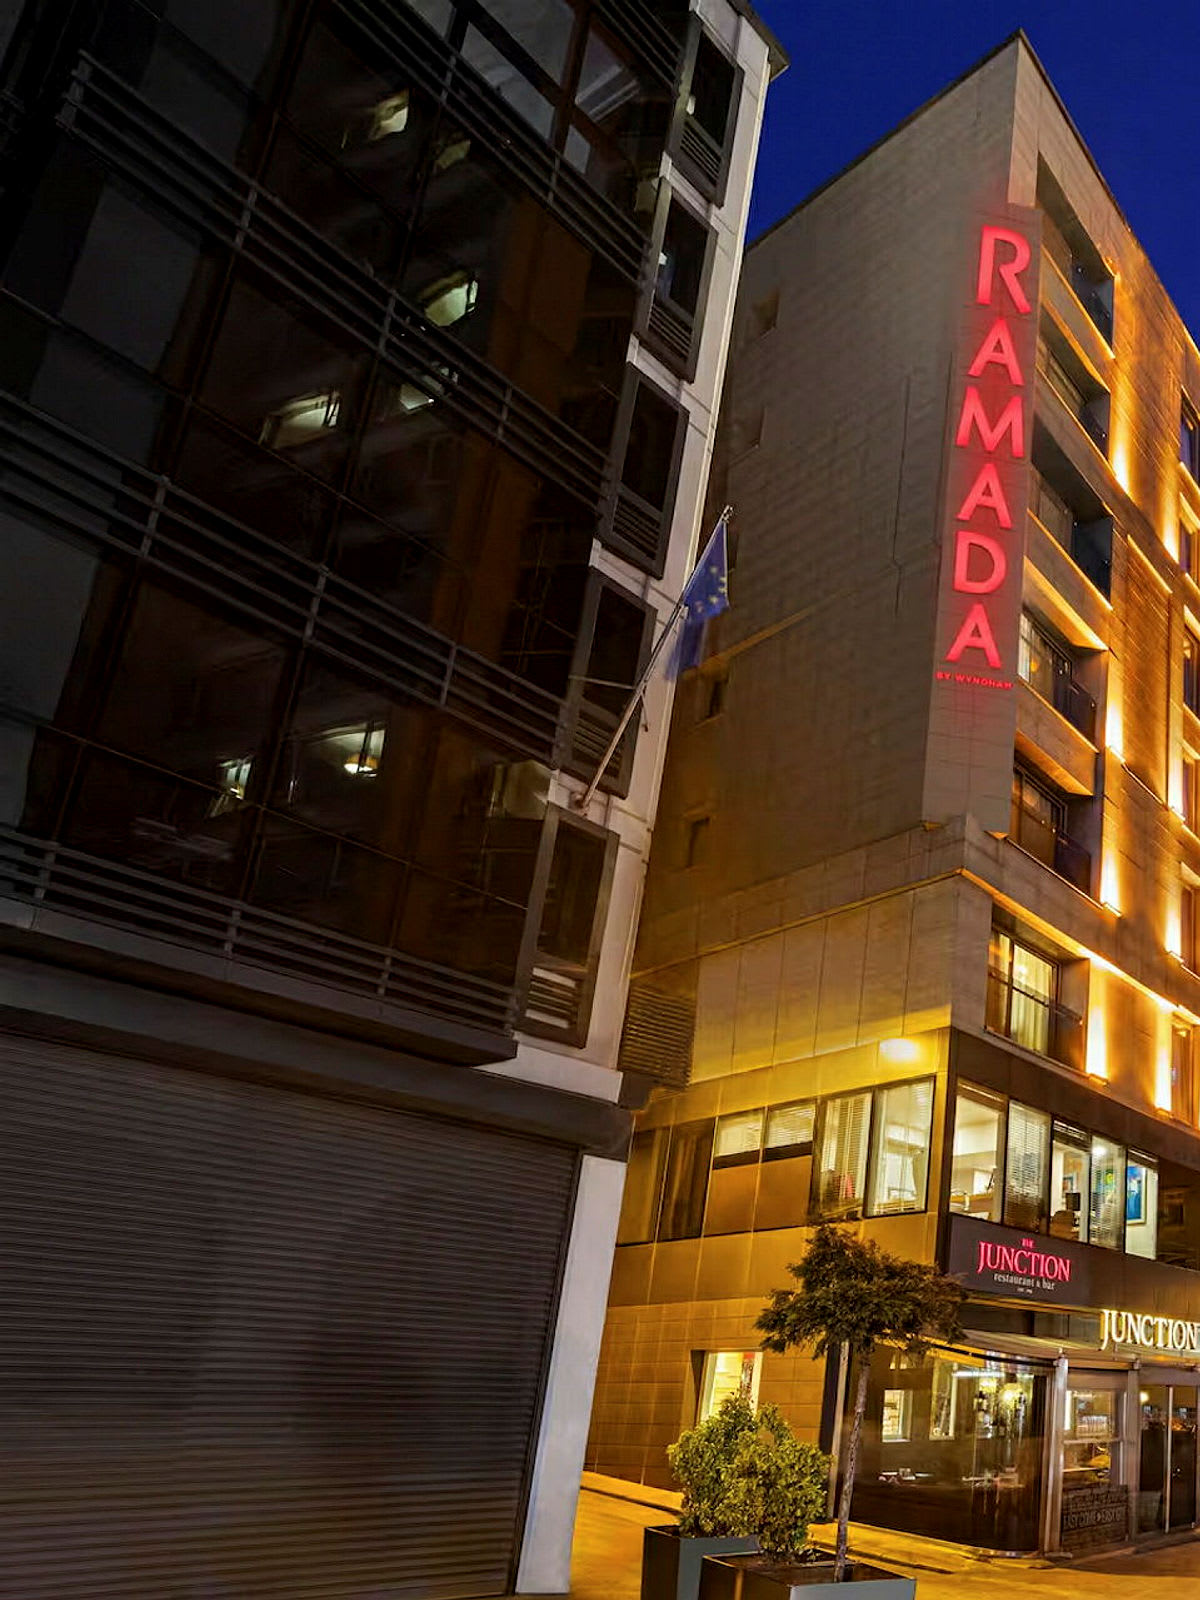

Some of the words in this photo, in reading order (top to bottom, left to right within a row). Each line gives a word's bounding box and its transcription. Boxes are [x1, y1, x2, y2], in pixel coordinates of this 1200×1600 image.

[945, 225, 1032, 669] RAMADA
[935, 671, 951, 681] BY
[955, 673, 1014, 690] WYNDHAM
[977, 1240, 1071, 1281] JUNCTION
[993, 1273, 1035, 1288] restaurant
[1042, 1279, 1055, 1291] bar
[1101, 1309, 1199, 1351] JUNCTION
